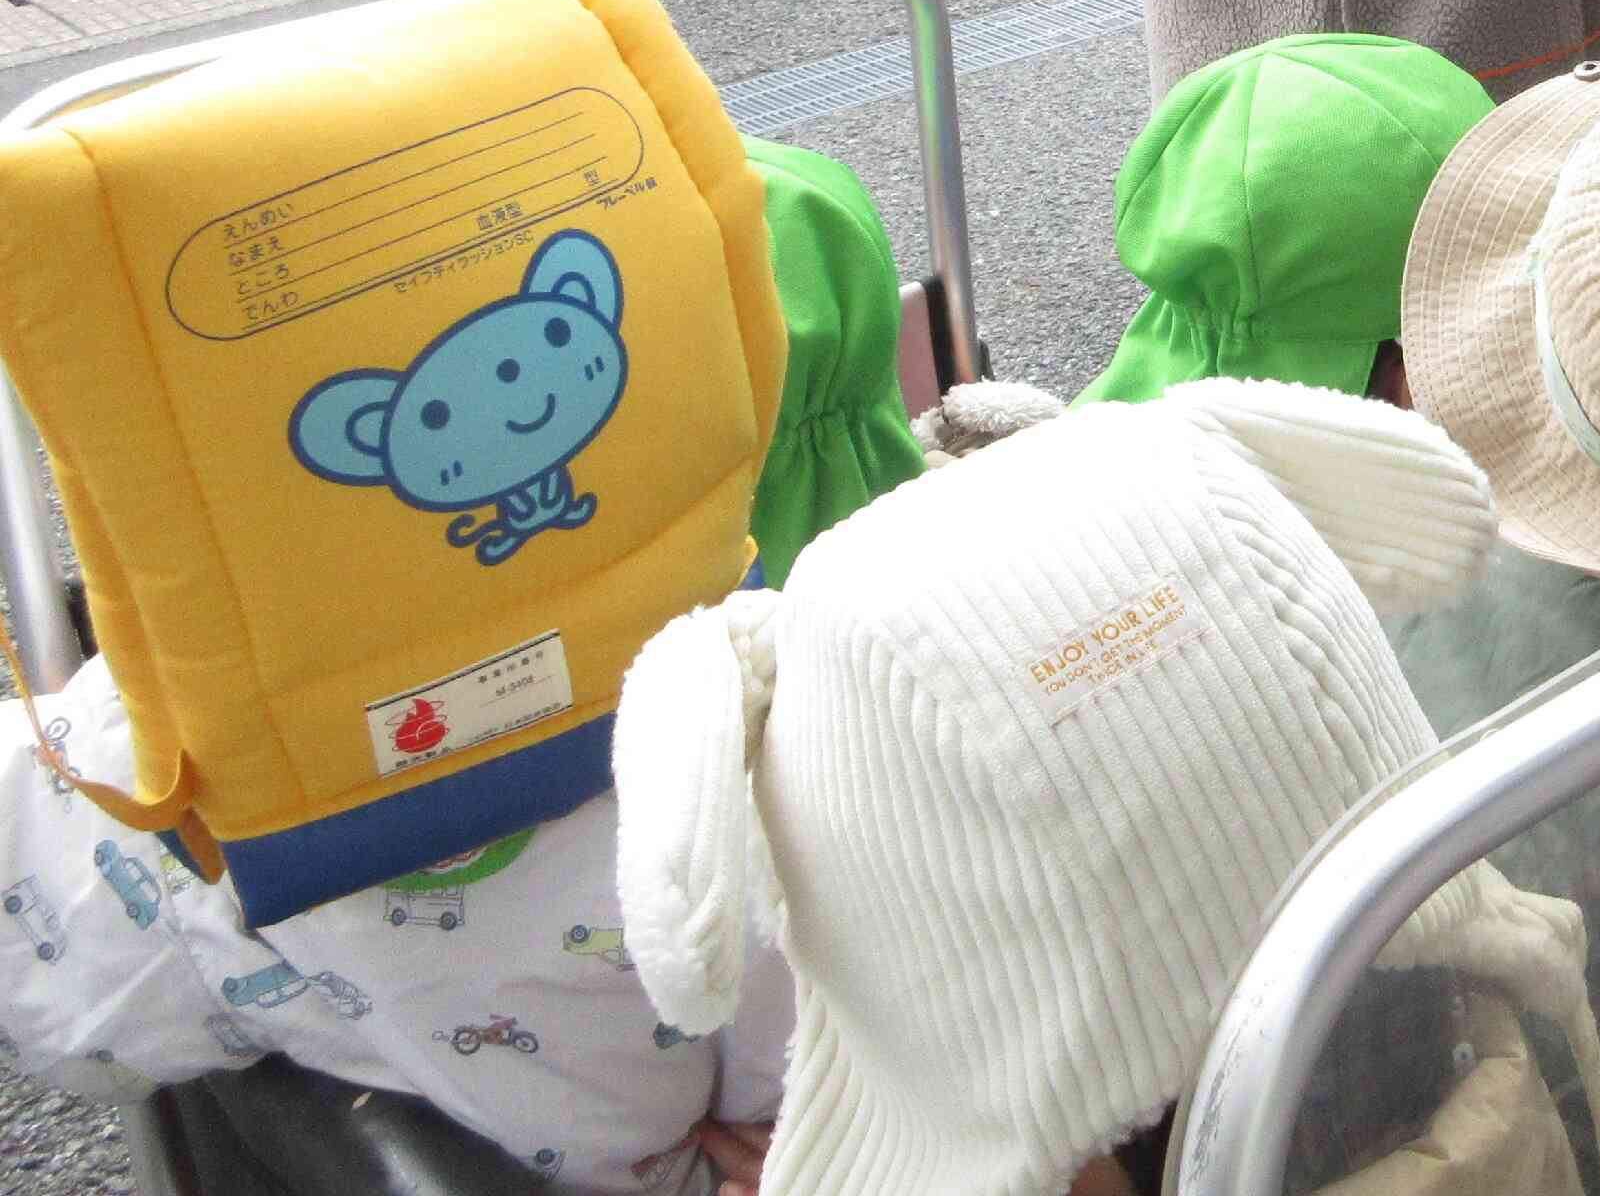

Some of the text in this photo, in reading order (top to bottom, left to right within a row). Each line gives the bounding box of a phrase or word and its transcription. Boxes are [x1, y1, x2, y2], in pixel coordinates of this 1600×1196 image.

[223, 203, 296, 239] えんめい
[476, 200, 524, 231] 血液型
[227, 235, 283, 267] なまえ
[236, 263, 290, 295] ところ
[244, 291, 299, 320] でんわ
[1030, 638, 1089, 684] ENJOY
[1091, 610, 1142, 646] YOUR
[1138, 585, 1178, 618] LIFE
